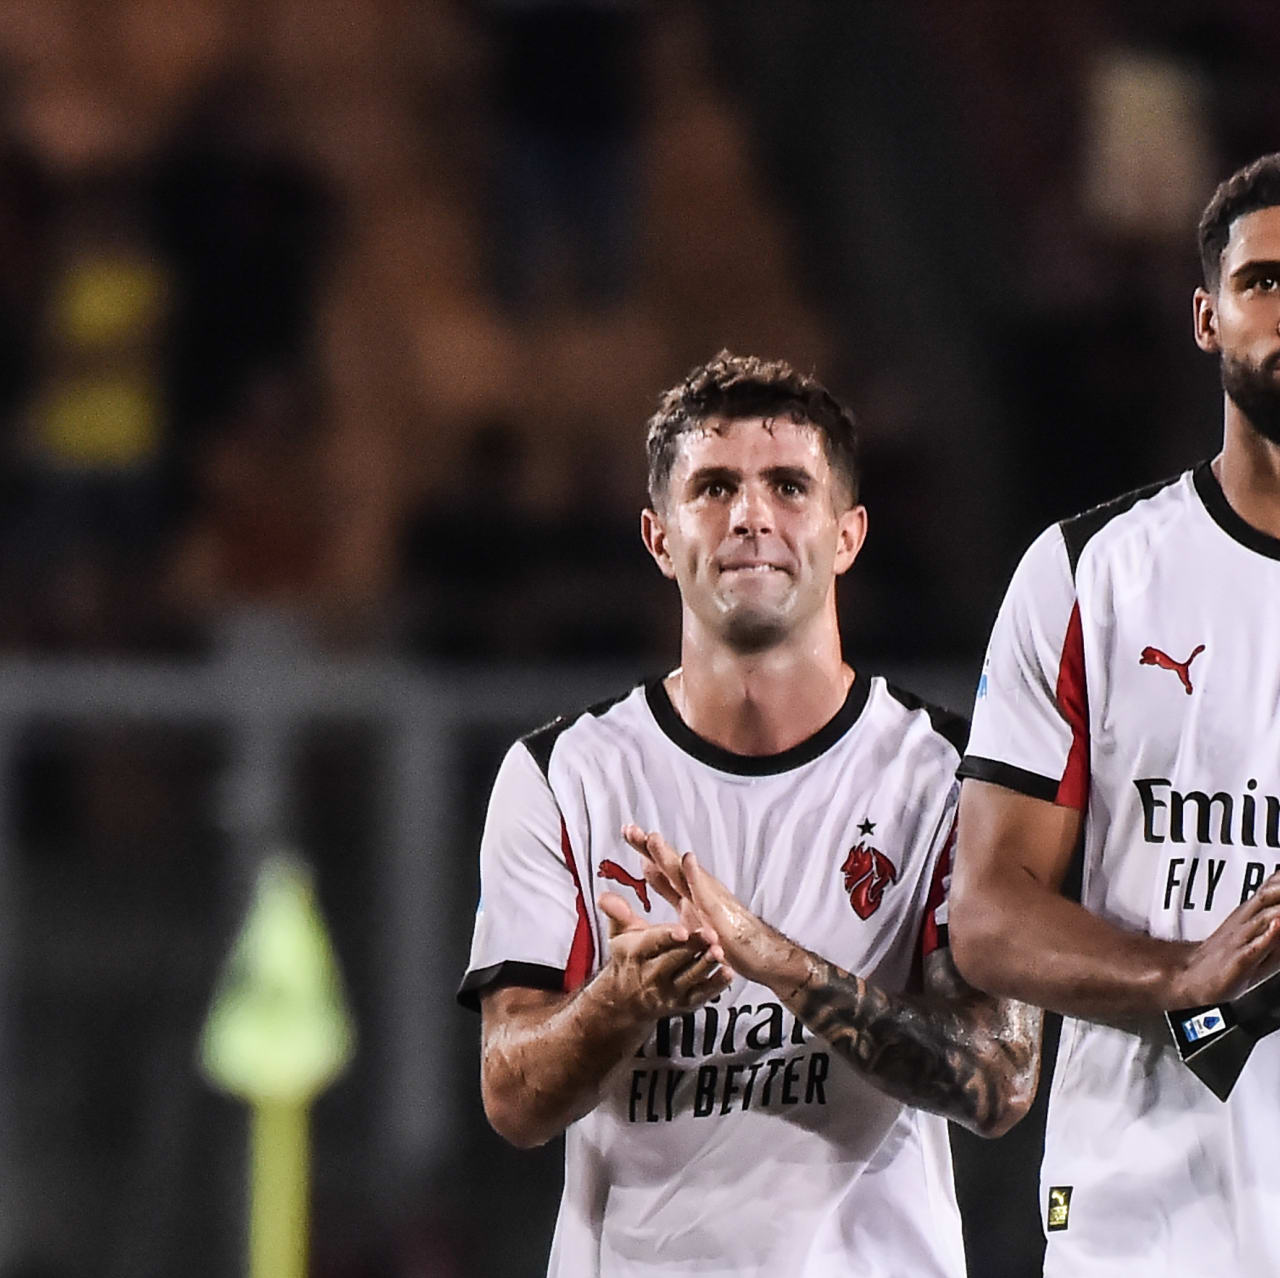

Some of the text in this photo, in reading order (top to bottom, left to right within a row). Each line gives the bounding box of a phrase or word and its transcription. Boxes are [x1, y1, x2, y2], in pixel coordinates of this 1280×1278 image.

[1163, 858, 1226, 911] FLY
[629, 1052, 830, 1122] FLY BETTER
